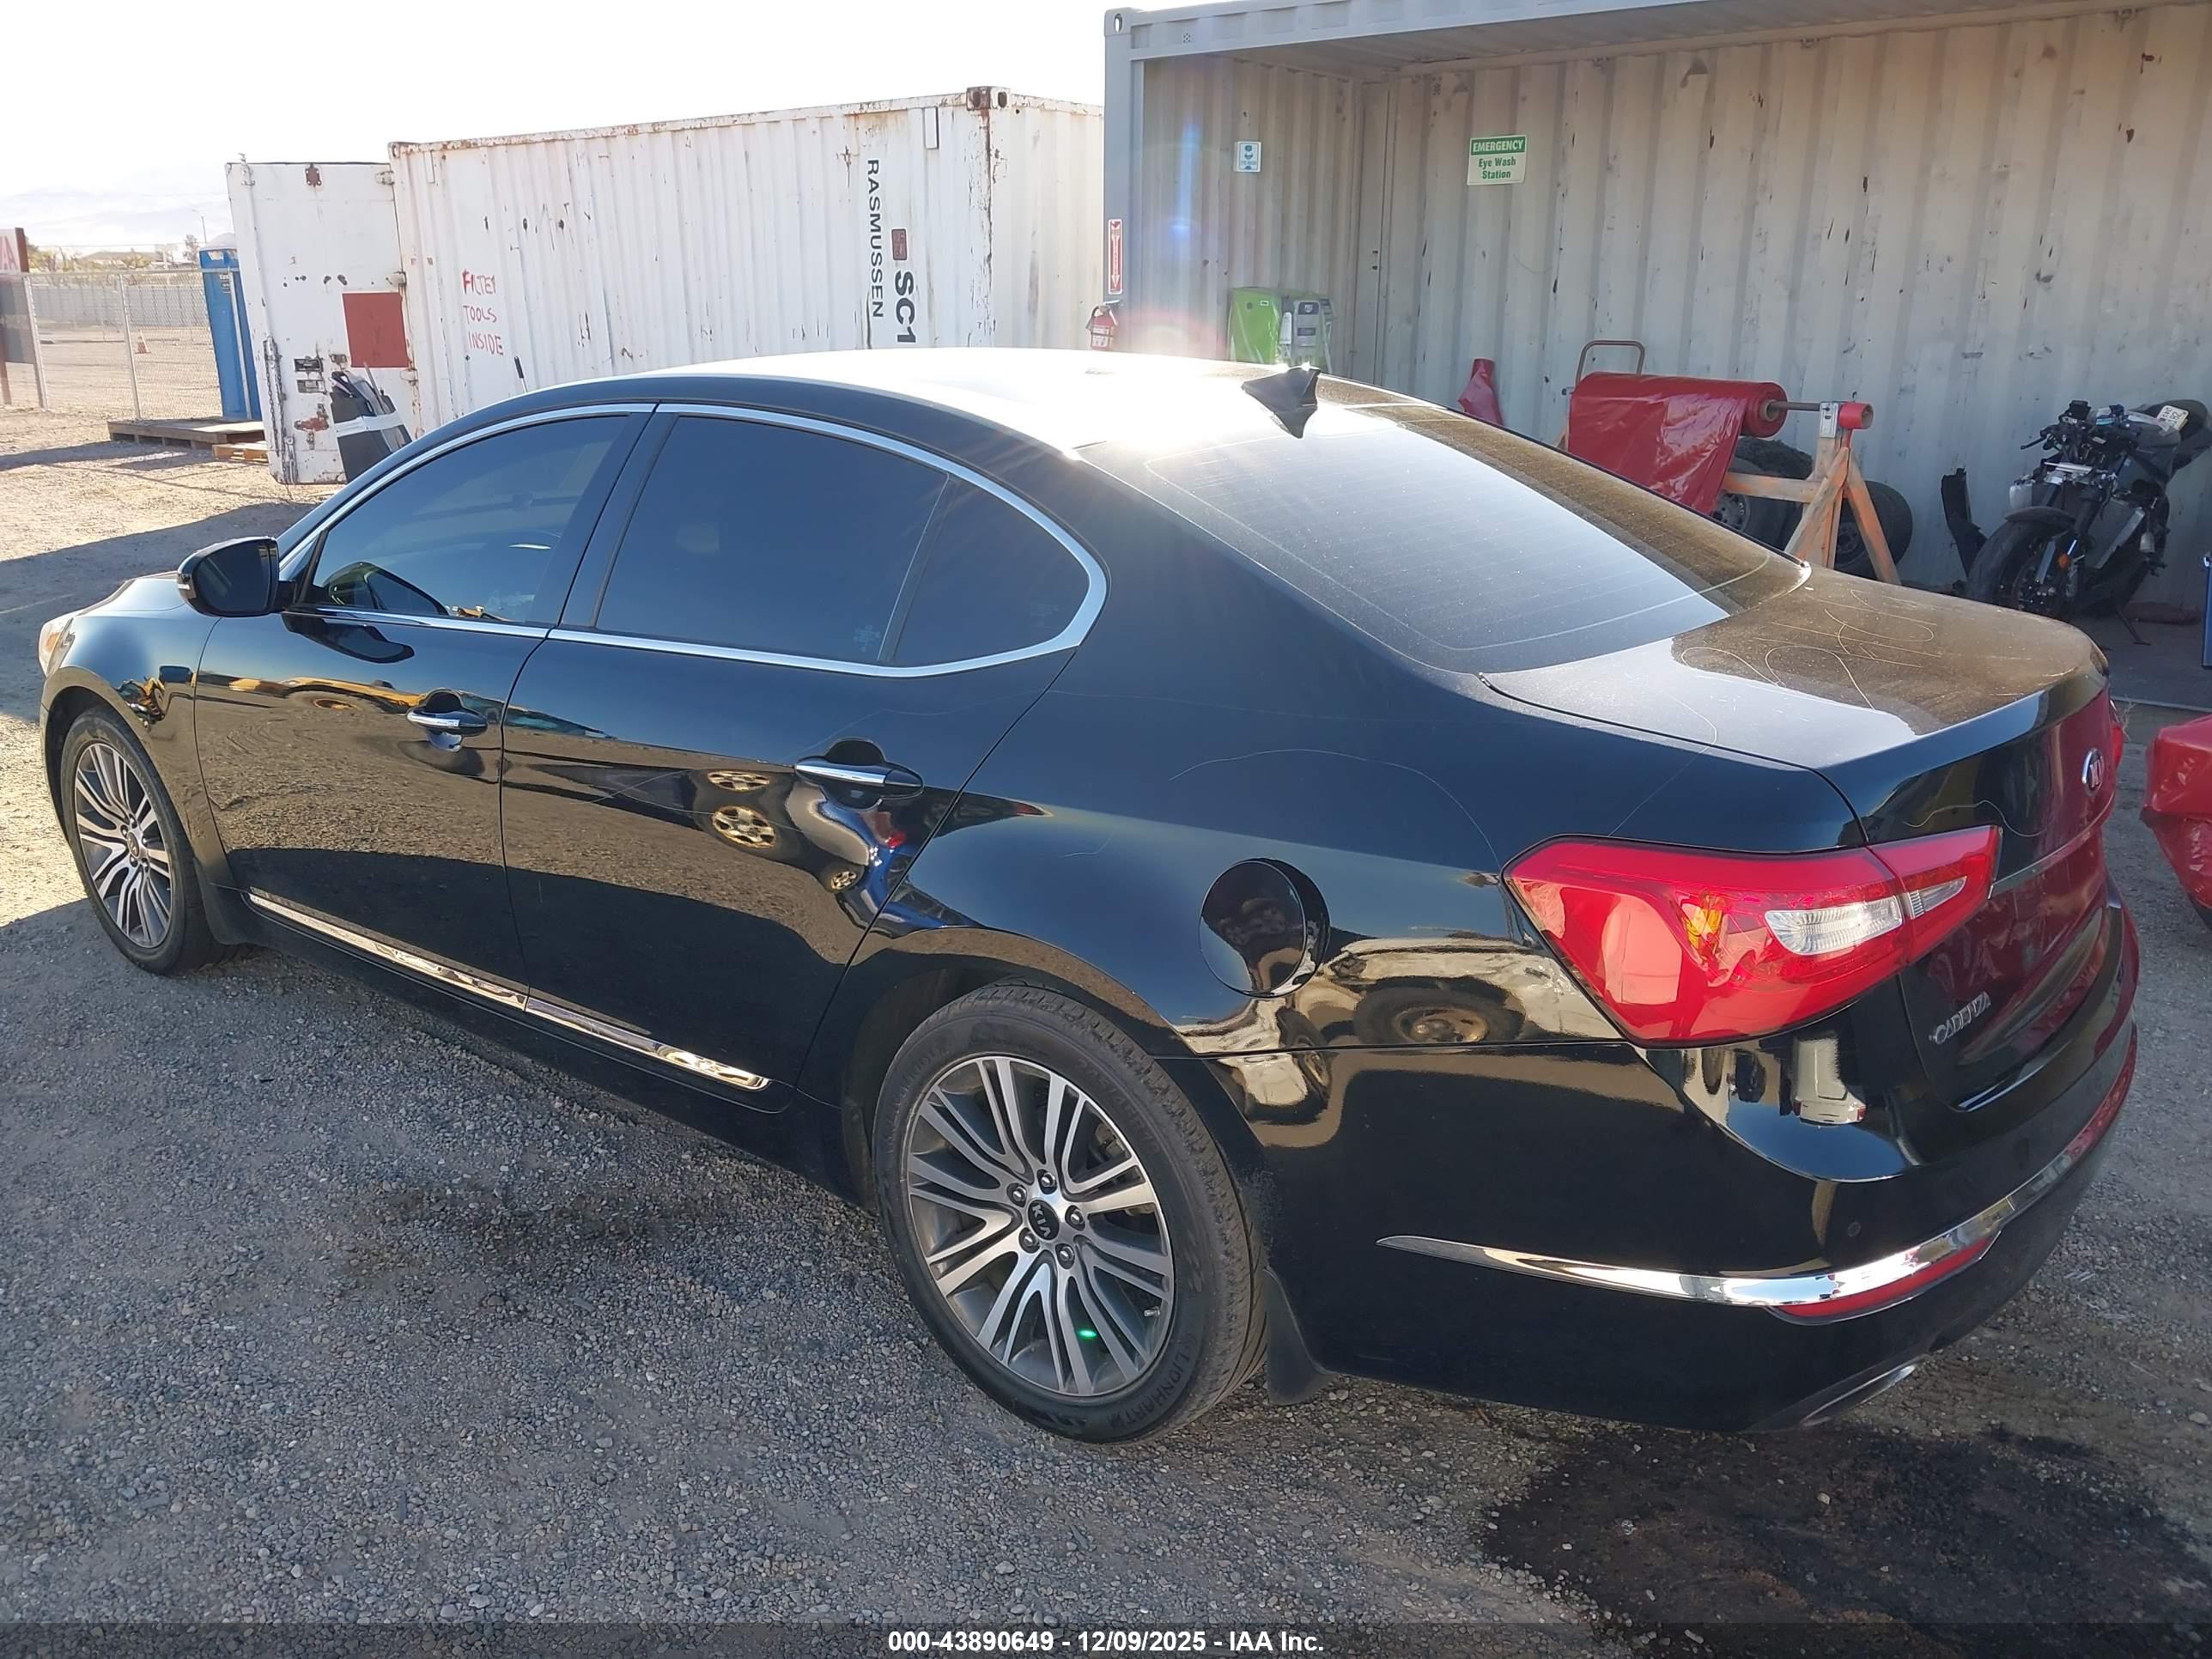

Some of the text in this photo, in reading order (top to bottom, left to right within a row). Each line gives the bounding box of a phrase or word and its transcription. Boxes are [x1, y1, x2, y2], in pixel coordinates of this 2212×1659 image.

[1473, 139, 1524, 152] EMERGENCY
[1478, 155, 1516, 170] Eye Wash
[1482, 169, 1511, 179] Station
[867, 159, 884, 318] RASMUSSEN
[462, 305, 497, 325] TOOLS
[894, 270, 916, 343] SC1
[468, 331, 504, 356] INSIDE
[1935, 991, 1991, 1044] CADENZA
[1031, 1204, 1051, 1237] KIA
[1125, 1352, 1192, 1425] LIONHART
